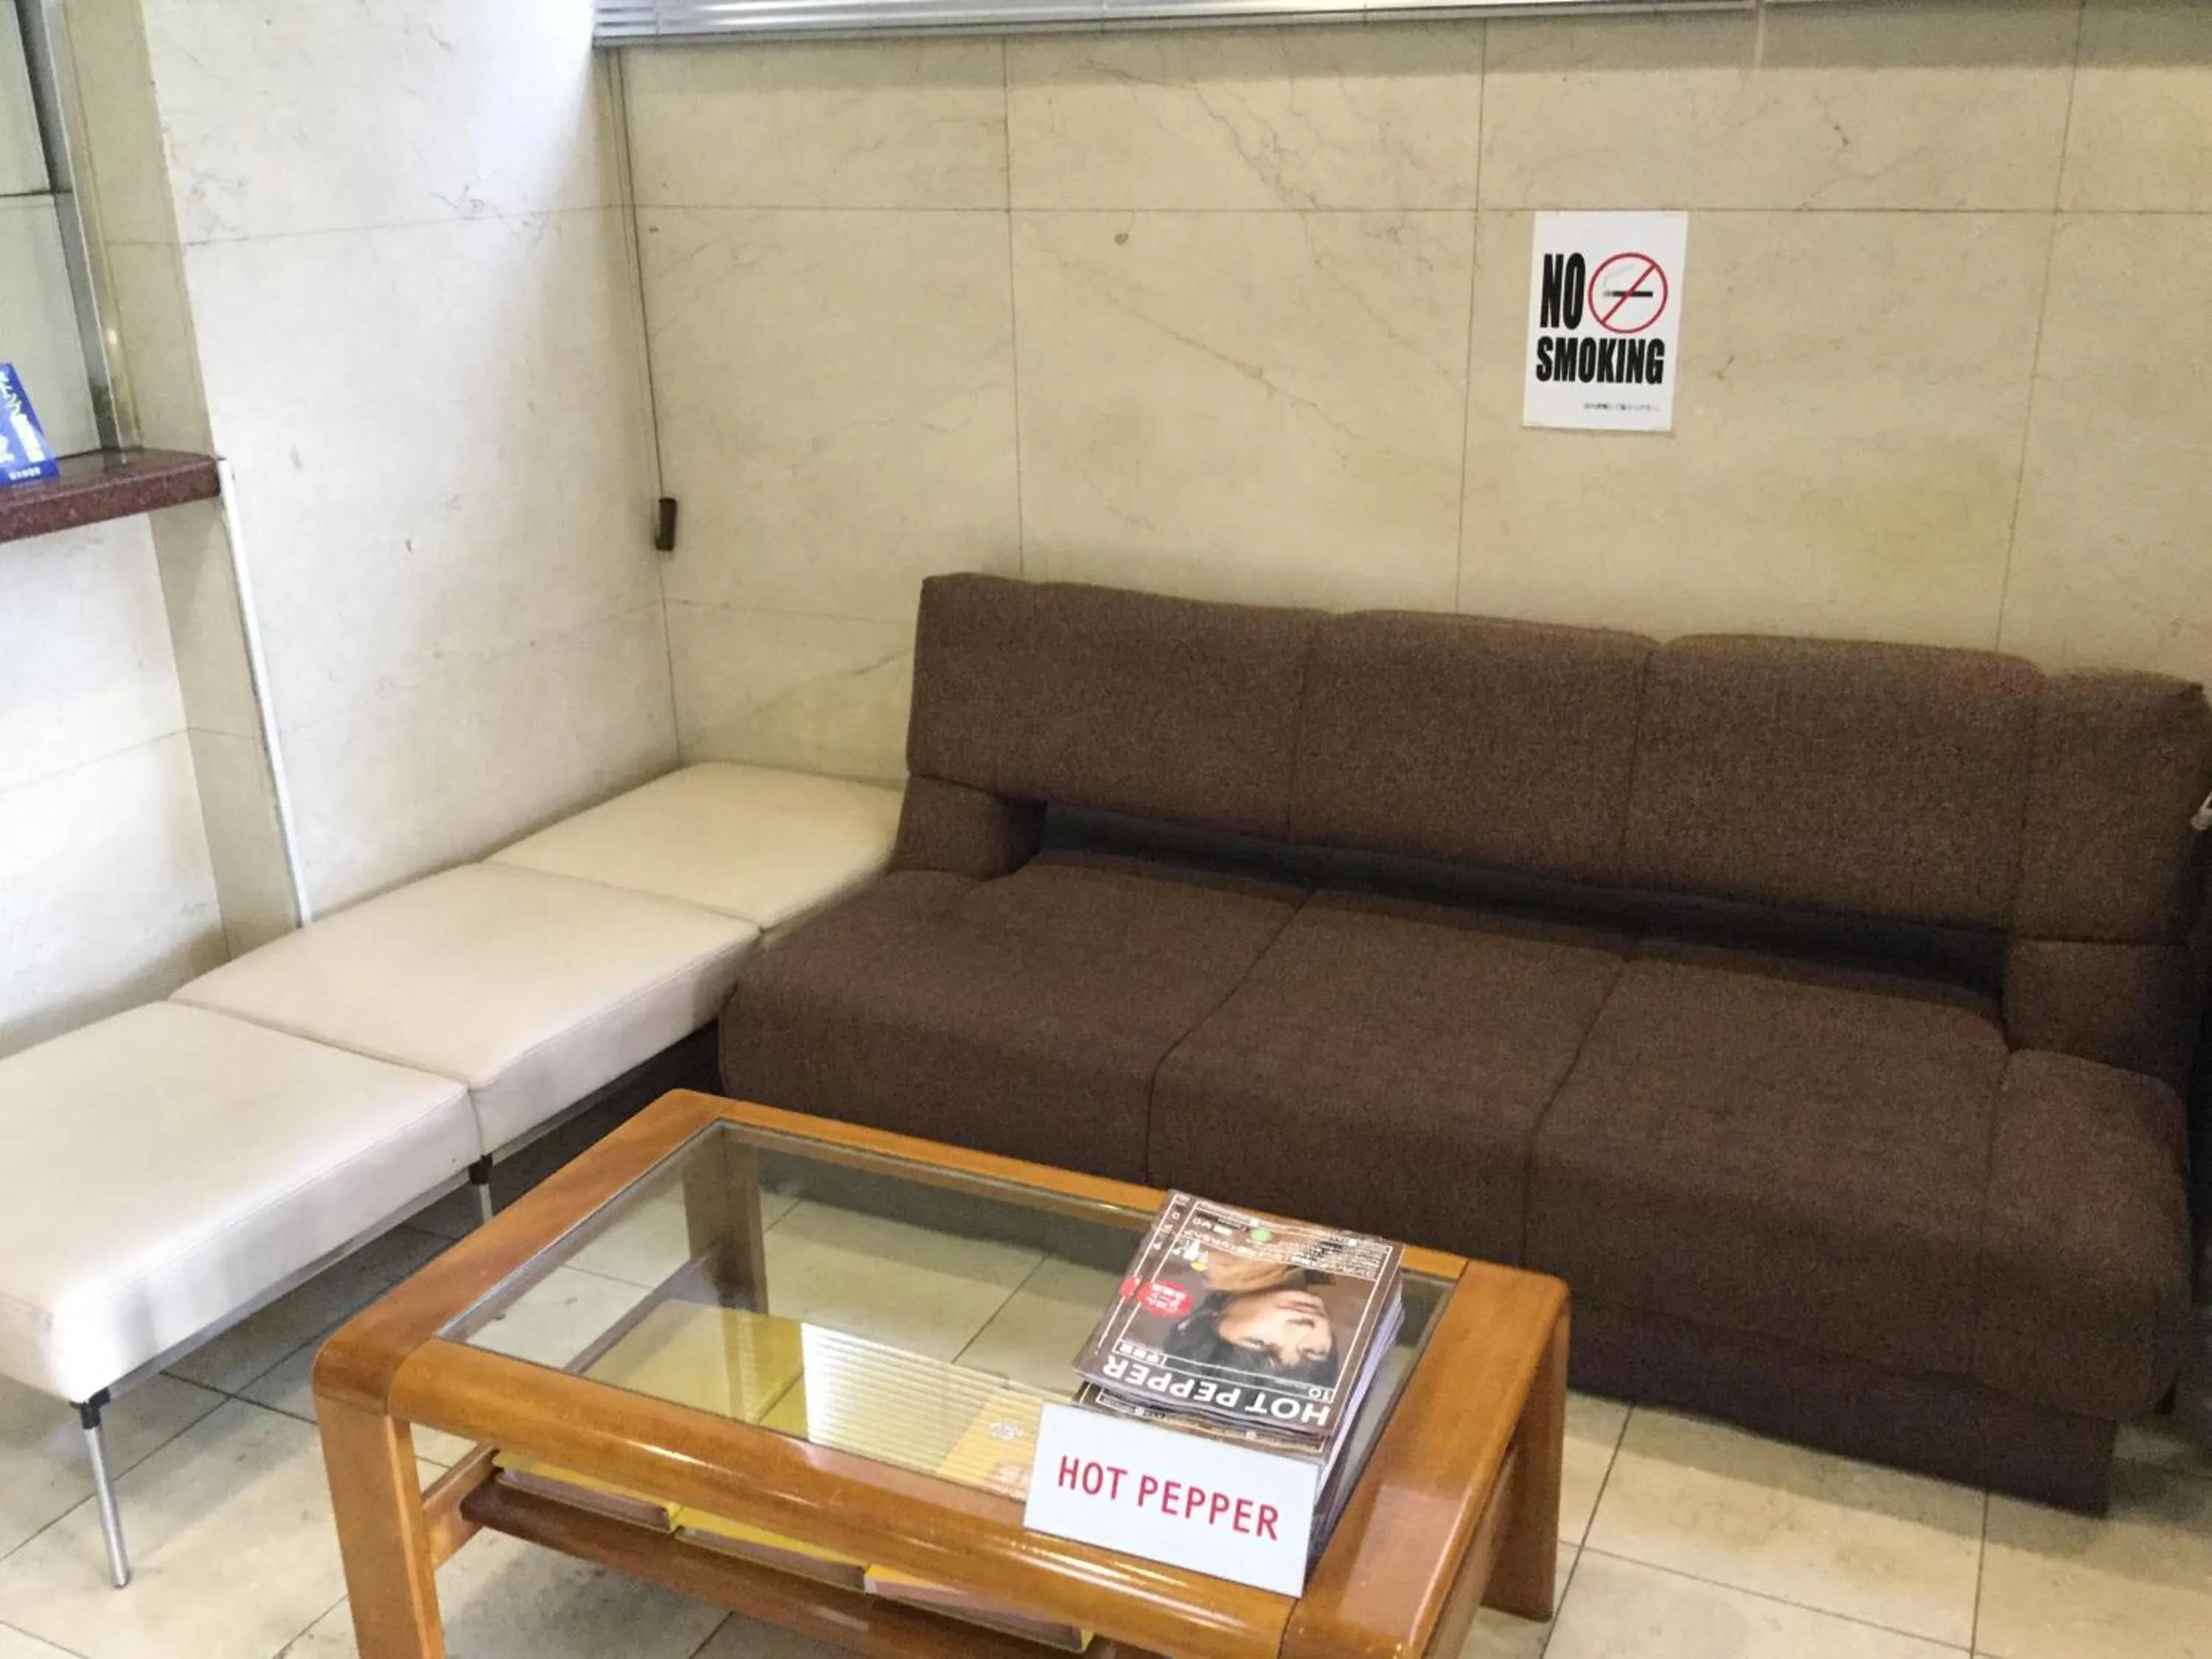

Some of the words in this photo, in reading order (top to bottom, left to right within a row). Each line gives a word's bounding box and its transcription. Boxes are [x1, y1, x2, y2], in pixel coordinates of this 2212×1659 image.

[1540, 252, 1585, 330] NO
[1536, 335, 1665, 384] SMOKING
[1102, 1355, 1240, 1406] PEPPER
[1245, 1393, 1331, 1426] HOT
[1058, 1456, 1128, 1500] HOT
[1138, 1474, 1279, 1540] PEPPER
